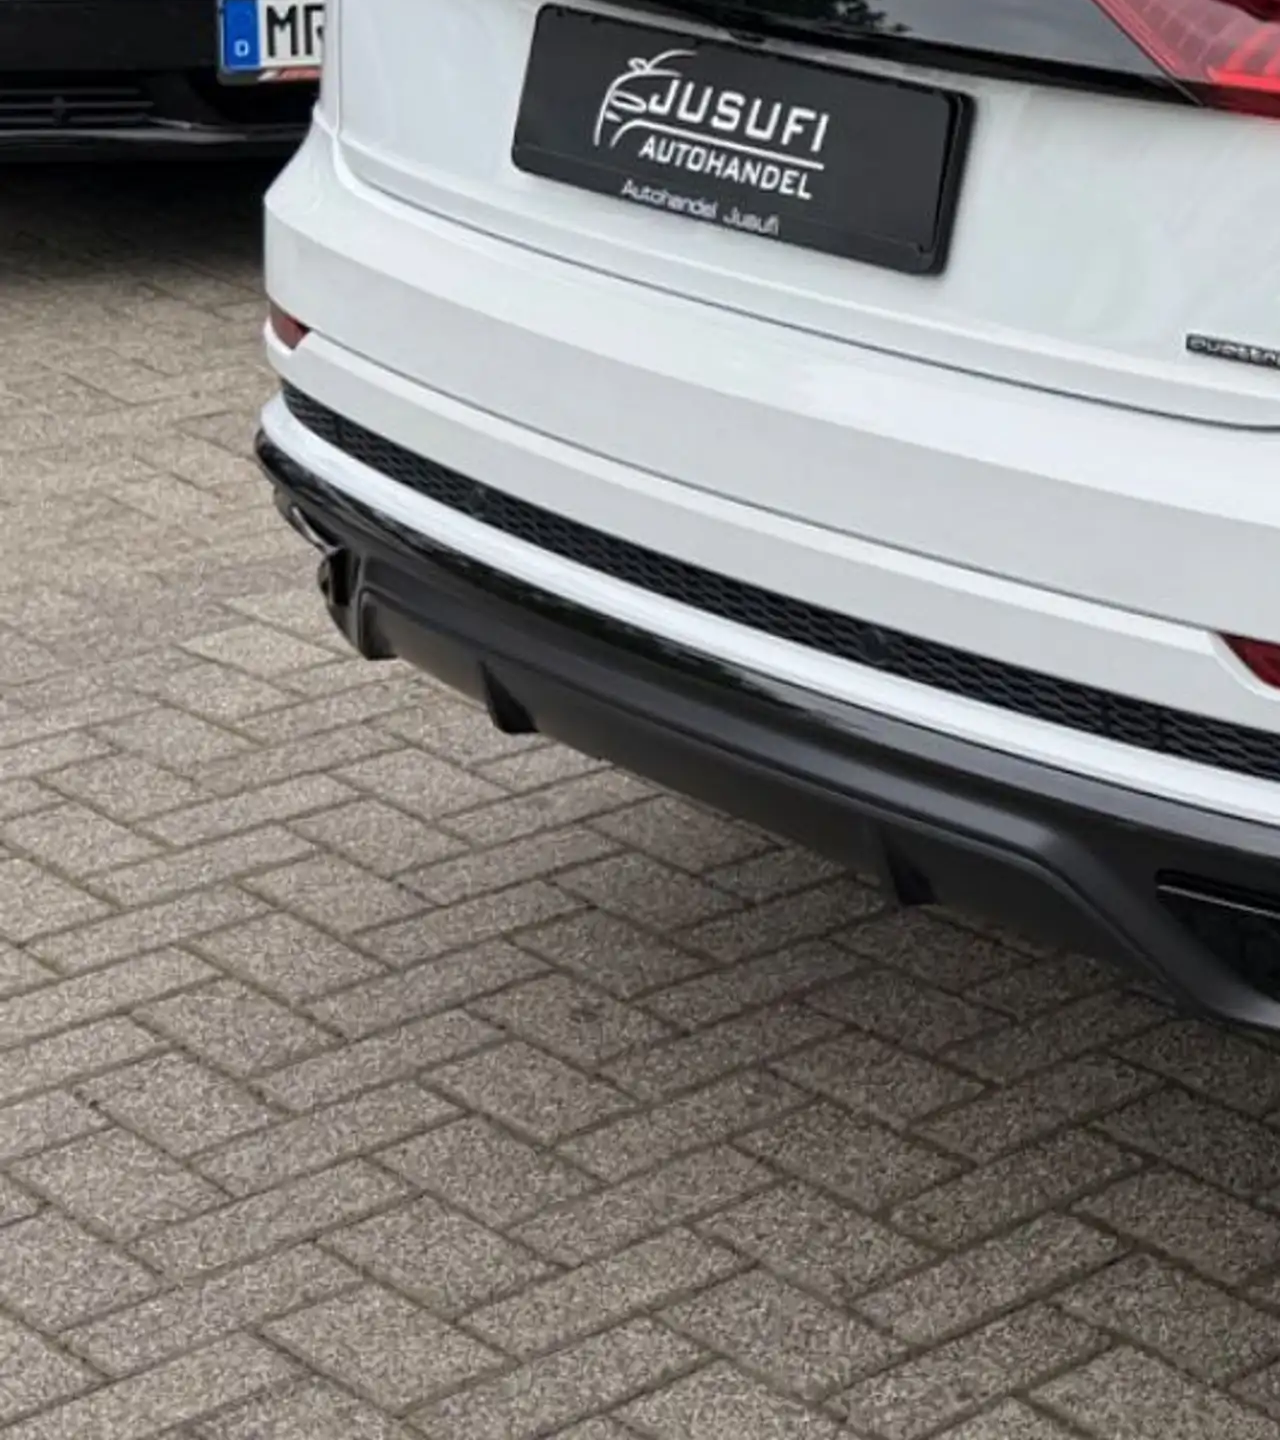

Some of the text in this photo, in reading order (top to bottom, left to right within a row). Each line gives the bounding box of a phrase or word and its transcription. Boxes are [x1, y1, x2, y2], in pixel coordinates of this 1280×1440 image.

[648, 78, 830, 153] JUSUFI
[638, 134, 813, 200] AUTOHANDEL
[620, 178, 781, 236] Autohandel Jusufi
